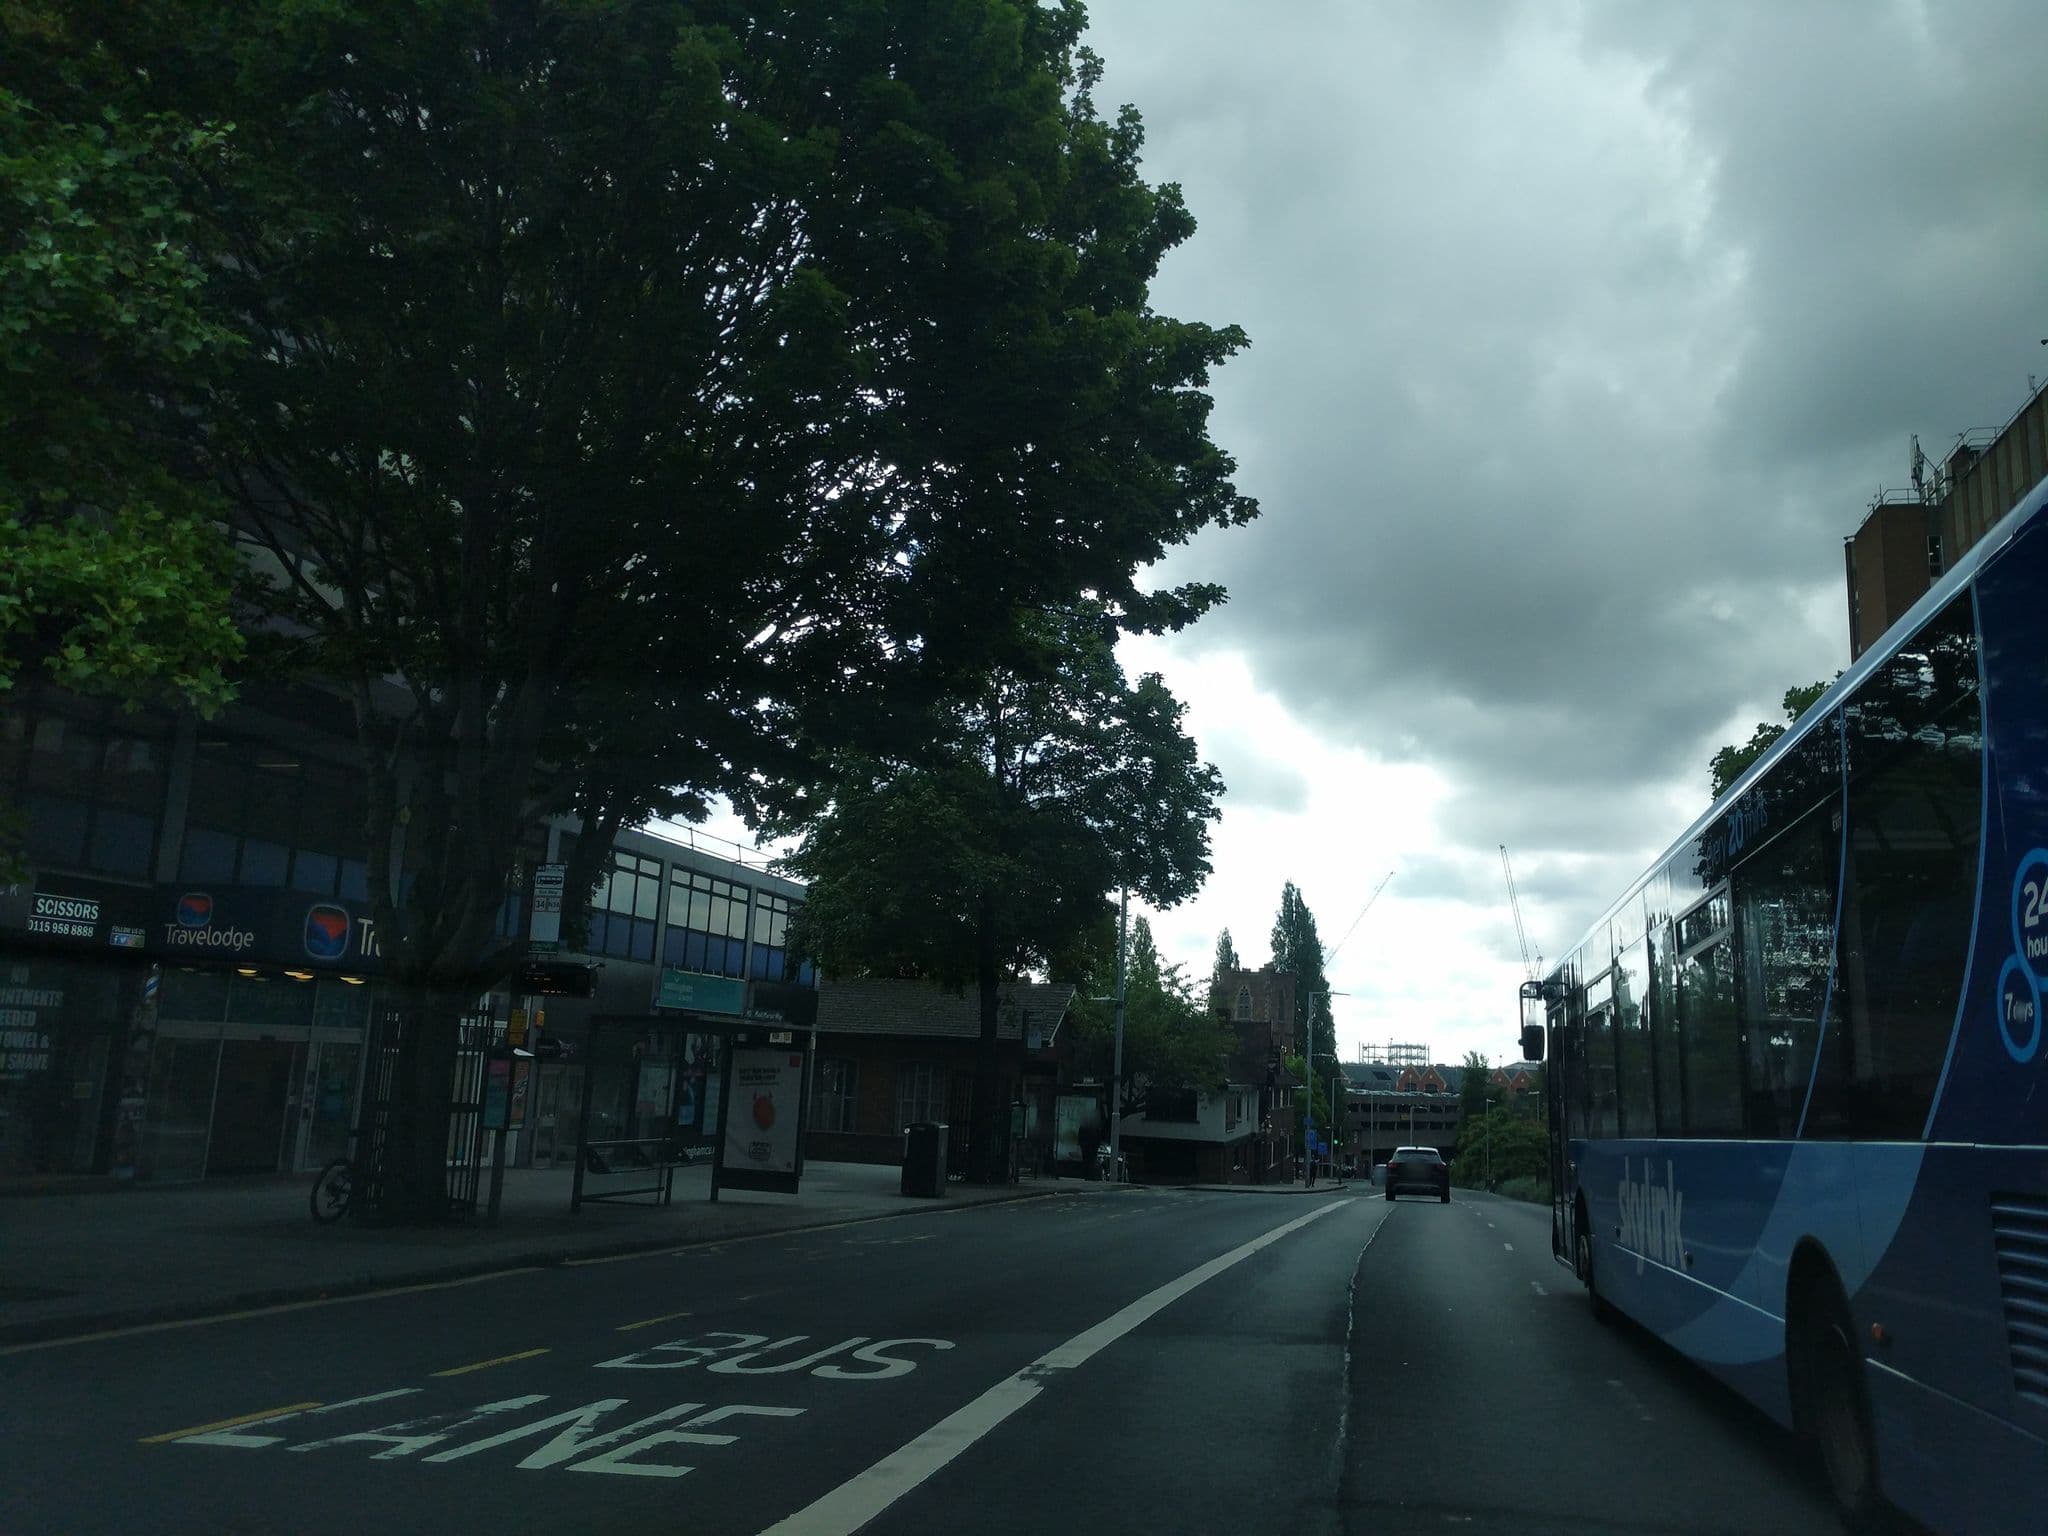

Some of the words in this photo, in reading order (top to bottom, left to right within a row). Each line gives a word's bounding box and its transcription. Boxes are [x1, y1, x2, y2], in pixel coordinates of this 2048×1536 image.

[1728, 809, 1744, 857] 20
[28, 919, 50, 933] 0115
[52, 922, 70, 936] 958
[71, 924, 95, 938] 8888
[36, 898, 100, 920] SCISSORS
[164, 922, 255, 952] Travelodge
[2004, 991, 2013, 1021] 7
[1618, 1155, 1688, 1277] skylink
[592, 1330, 957, 1381] BUS
[172, 1386, 808, 1479] LANE
